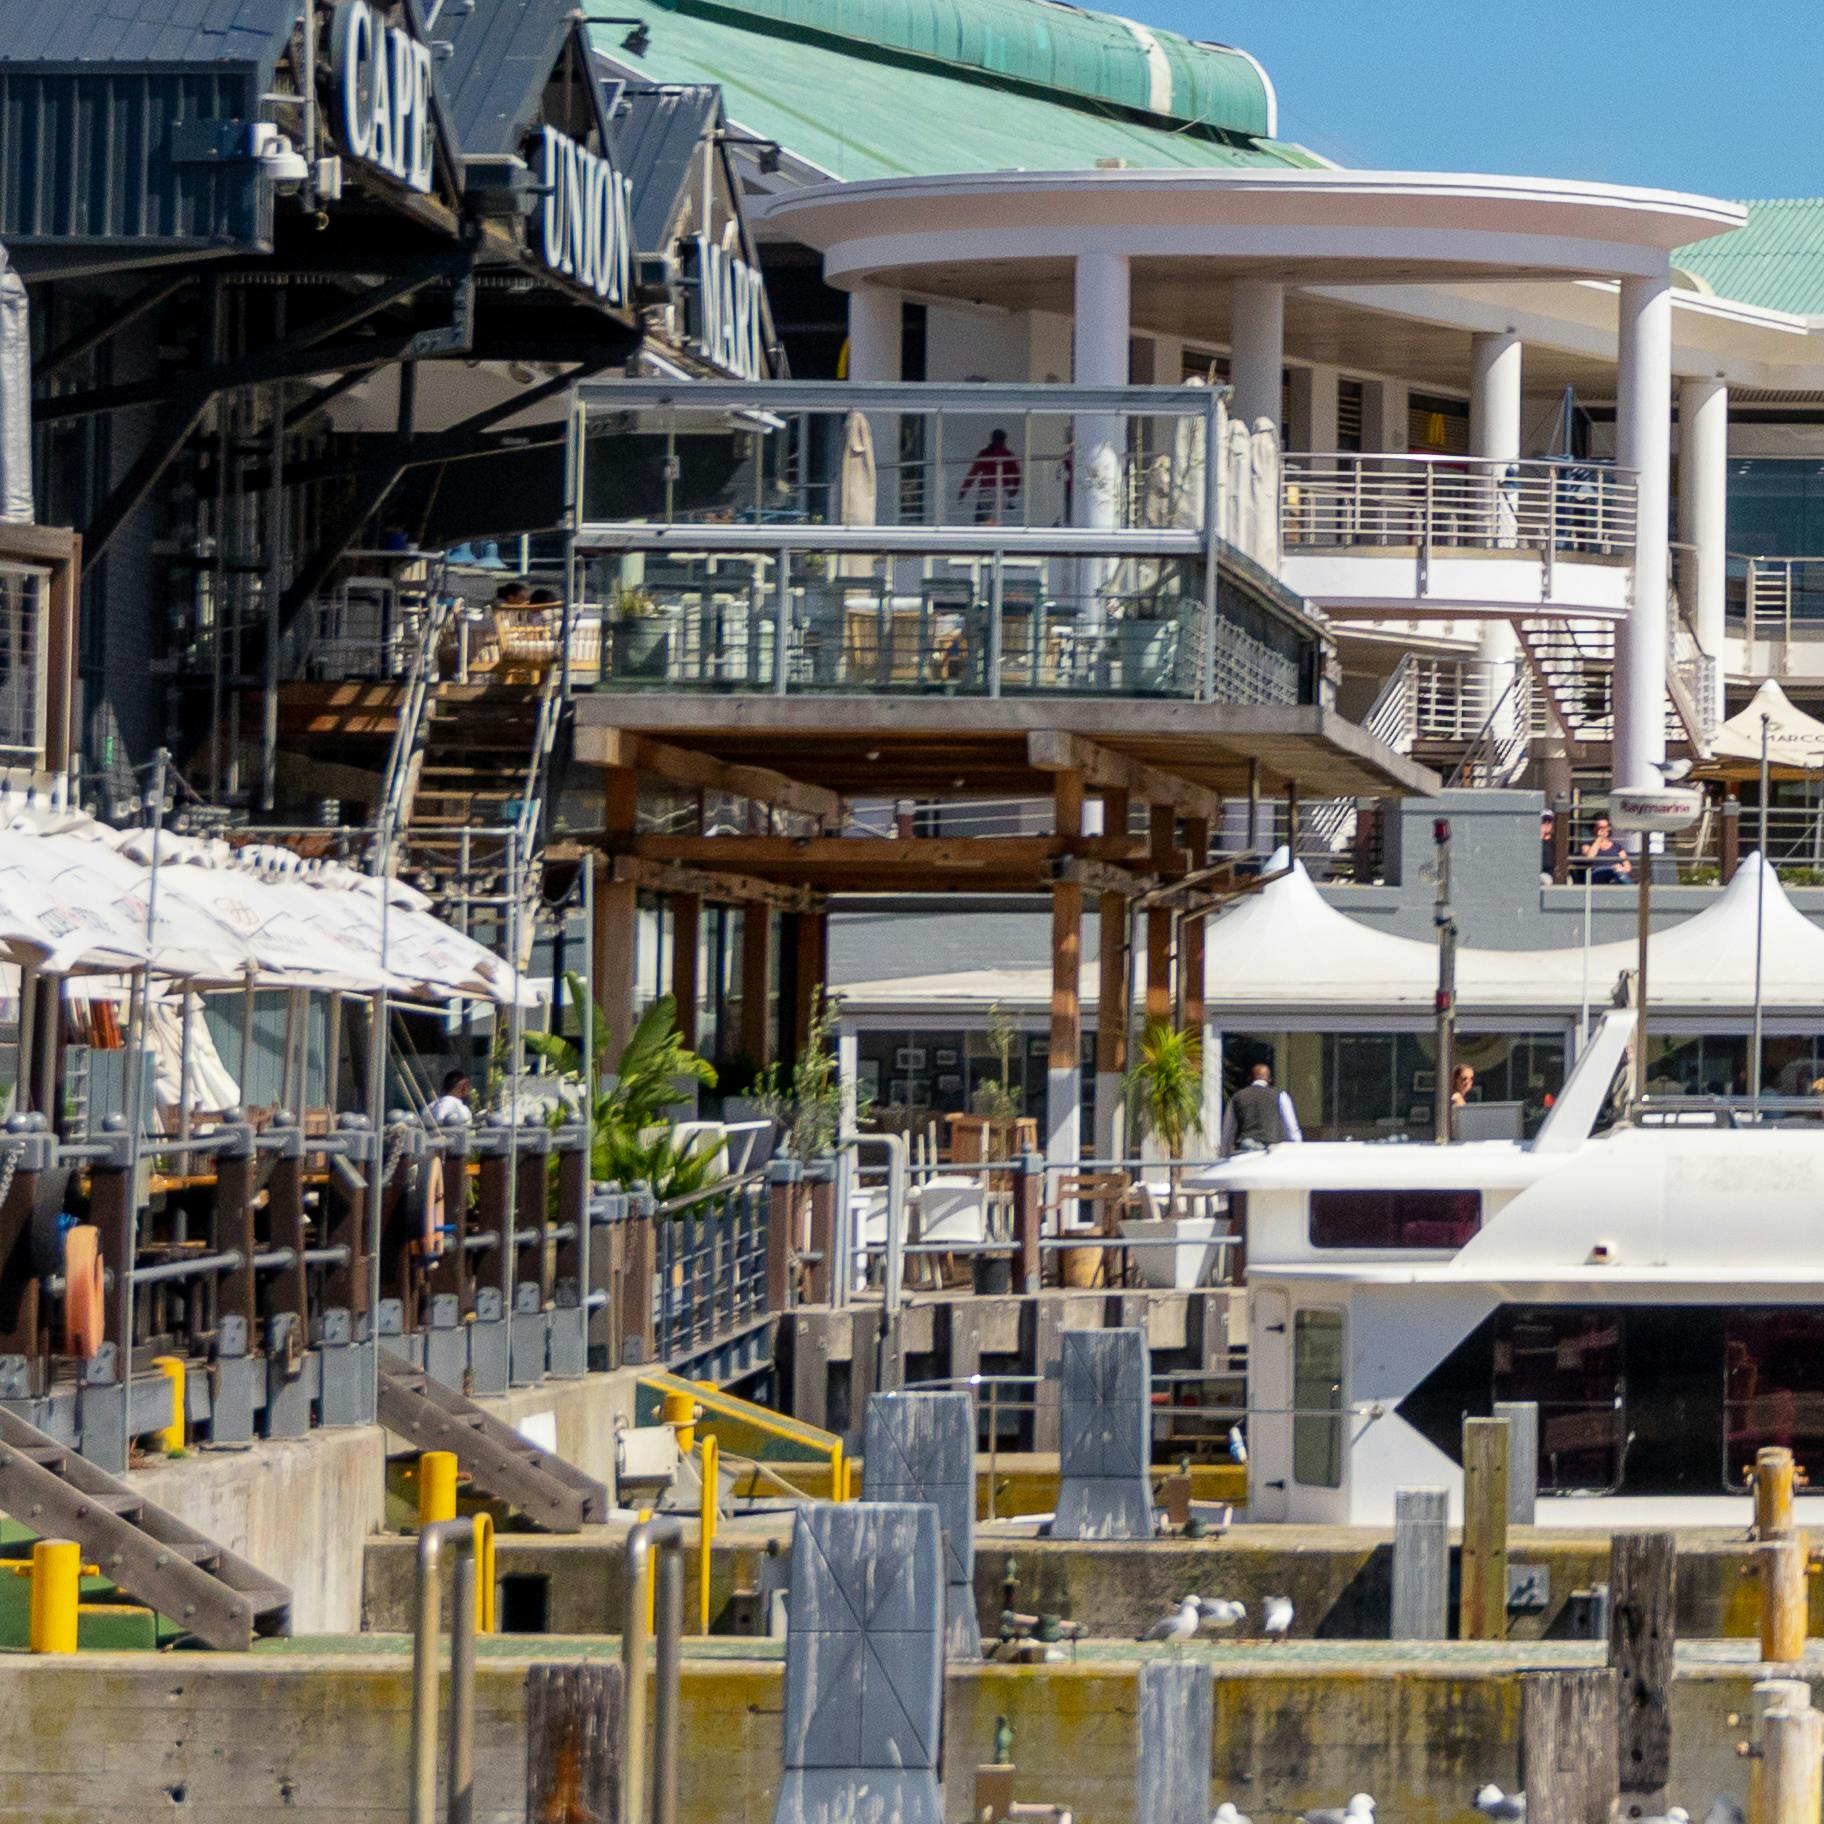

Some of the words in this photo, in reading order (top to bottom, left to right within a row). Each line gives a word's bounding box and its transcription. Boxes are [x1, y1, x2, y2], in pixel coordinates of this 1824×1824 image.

[345, 0, 431, 193] CAPE
[544, 125, 633, 309] UNION
[1621, 800, 1690, 815] Raymarine
